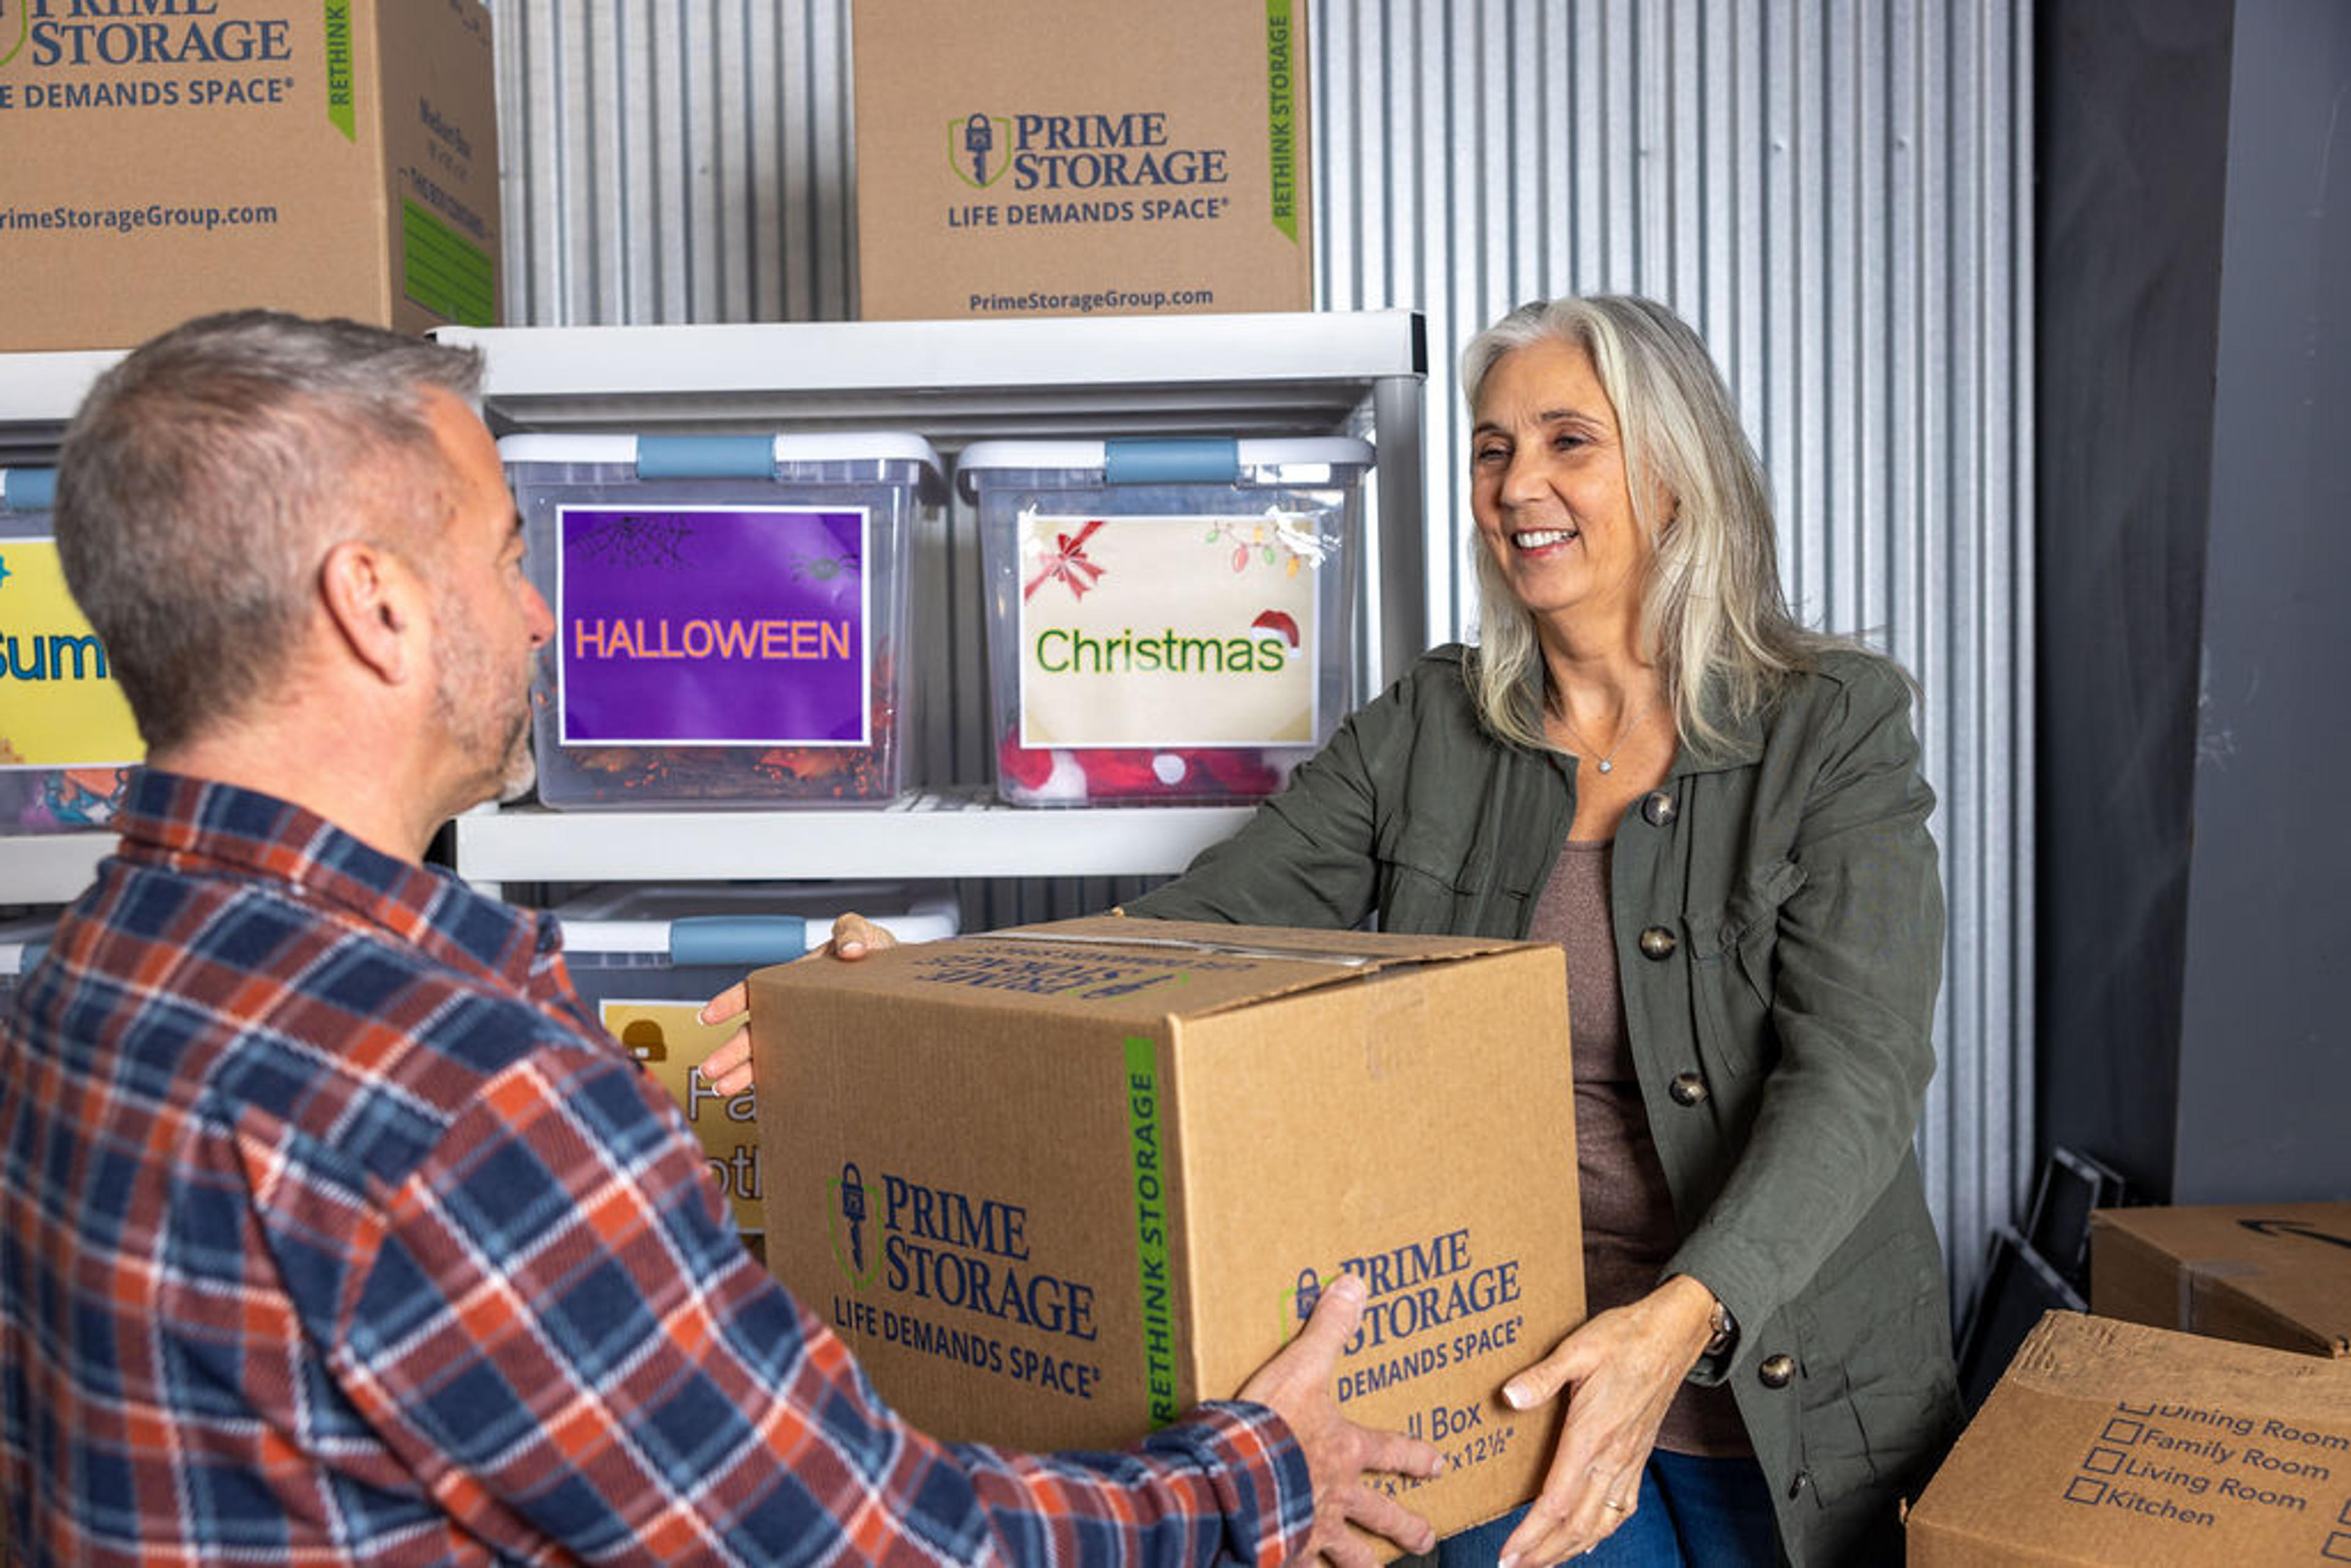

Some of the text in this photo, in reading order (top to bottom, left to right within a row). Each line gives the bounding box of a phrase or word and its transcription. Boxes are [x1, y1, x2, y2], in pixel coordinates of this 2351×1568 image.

[32, 20, 292, 66] STORAGE
[327, 7, 350, 105] RETHINK
[25, 81, 179, 108] DEMANDS
[1269, 15, 1291, 217] RETHINK STORAGE
[1013, 113, 1168, 151] PRIME
[1014, 150, 1229, 190] STORAGE
[948, 205, 999, 227] LIFE
[1007, 201, 1134, 224] DEMANDS
[970, 290, 1213, 312] PrimeStorageGroup.com
[0, 631, 106, 680] um
[575, 620, 850, 659] HALLOWEEN
[1037, 629, 1285, 672] Christmas
[882, 1173, 1030, 1261] PRIME
[1131, 1073, 1173, 1424] RETHINK STORAGE
[885, 1234, 1098, 1341] STORAGE
[834, 1295, 877, 1337] LIFE
[883, 1310, 1002, 1373] DEMANDS
[1338, 1343, 1447, 1402] DEMANDS
[1432, 1403, 1482, 1442] Box
[2160, 1403, 2350, 1451] Dining Room
[2142, 1428, 2330, 1481] Family Room
[2105, 1488, 2215, 1526] Kitchen
[2125, 1458, 2307, 1512] Living Room
